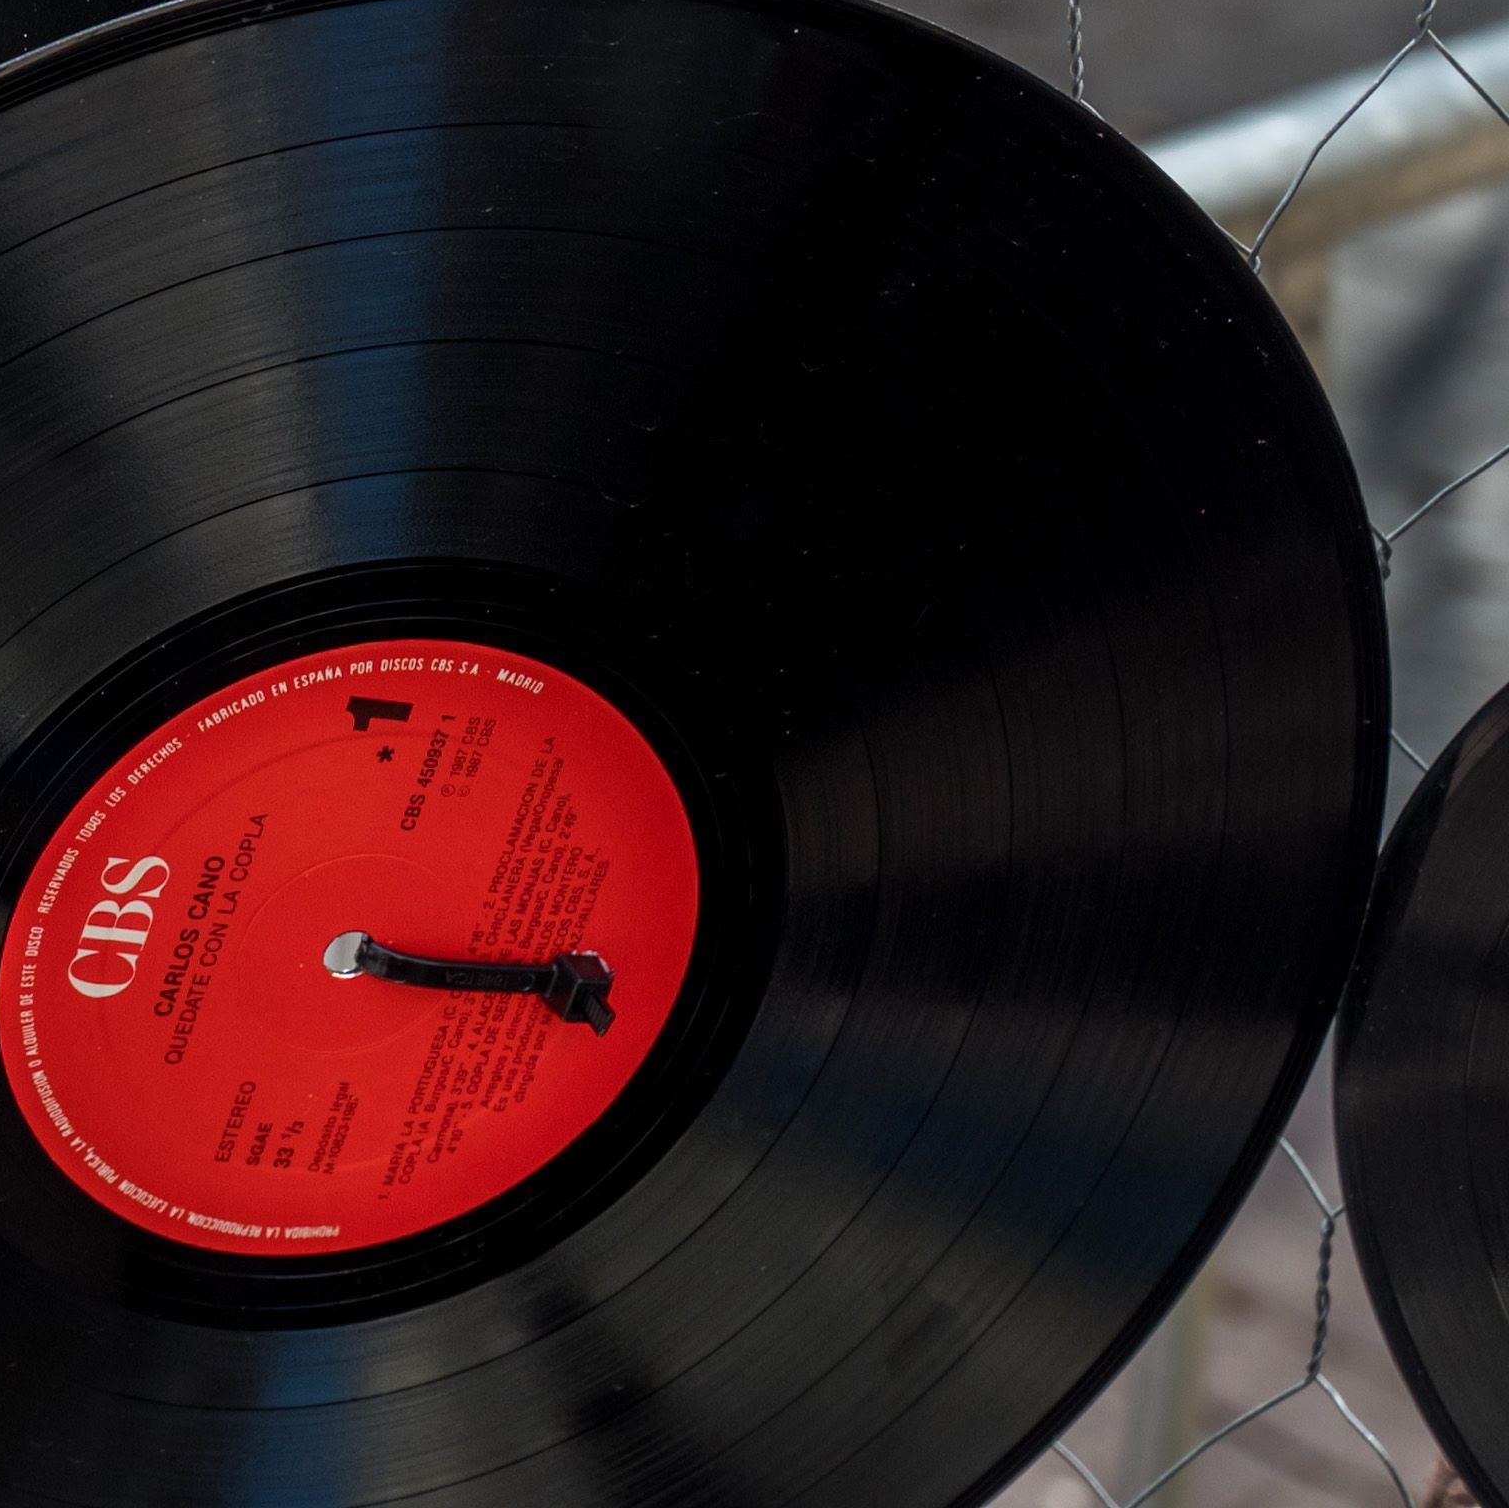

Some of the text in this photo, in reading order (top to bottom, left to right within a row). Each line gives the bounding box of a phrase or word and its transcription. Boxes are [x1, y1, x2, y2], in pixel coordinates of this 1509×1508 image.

[196, 656, 546, 734] FABRICADO EN ESPAÑA POR DISCOS CBS MADRID
[448, 715, 482, 779] 1987 CBS
[463, 717, 498, 779] 1987 CBS
[35, 736, 184, 915] RESERVADOS TODOS LOS DERECHOS
[398, 713, 458, 833] CBS 450937 1
[486, 781, 541, 895] PROCLAMACION
[66, 855, 172, 999] CBS
[152, 854, 227, 1019] CARLOS CANO
[163, 812, 271, 1067] QUEDATE CON LA COPLA
[483, 850, 529, 948] CHICLANERA
[18, 925, 187, 1221] LA EJECUCION PUBLICA, LA RADIODIFUSION ALQUILER DE ESTE DISCO
[212, 1079, 258, 1165] ESTEREO
[244, 1121, 275, 1168] SGAE
[271, 1146, 296, 1170] 33
